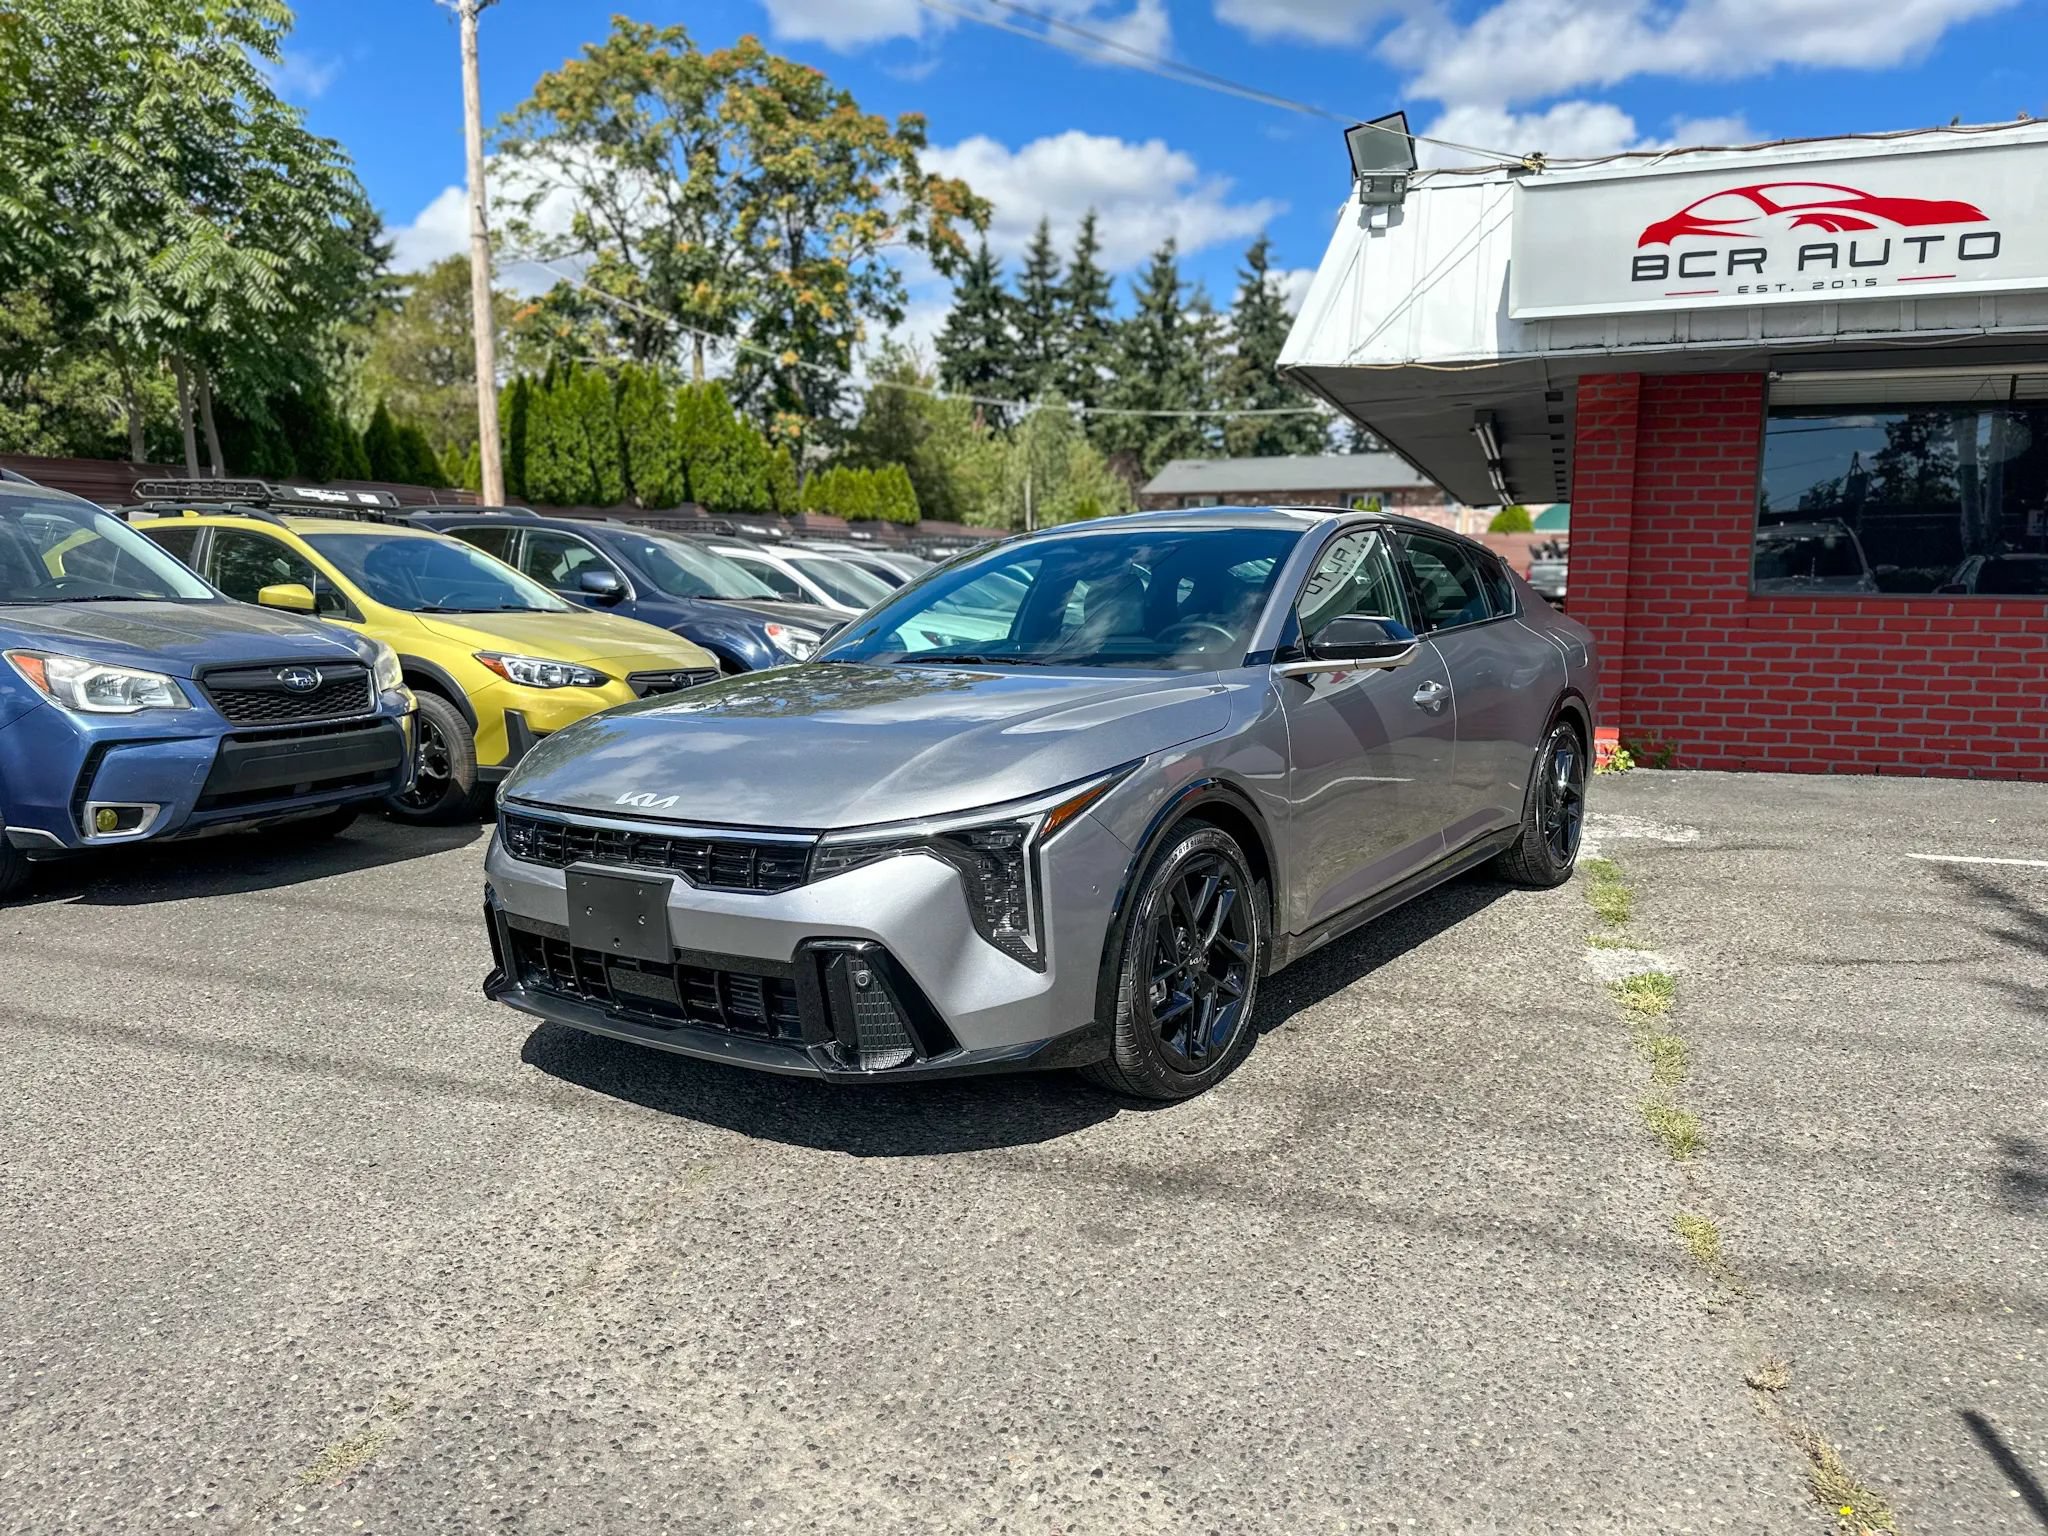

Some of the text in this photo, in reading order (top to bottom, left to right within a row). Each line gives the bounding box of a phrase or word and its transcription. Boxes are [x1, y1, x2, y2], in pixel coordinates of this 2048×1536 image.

[1631, 231, 2001, 282] BCR AUTO
[1737, 277, 1877, 294] EST. 2015
[615, 791, 680, 809] KIA
